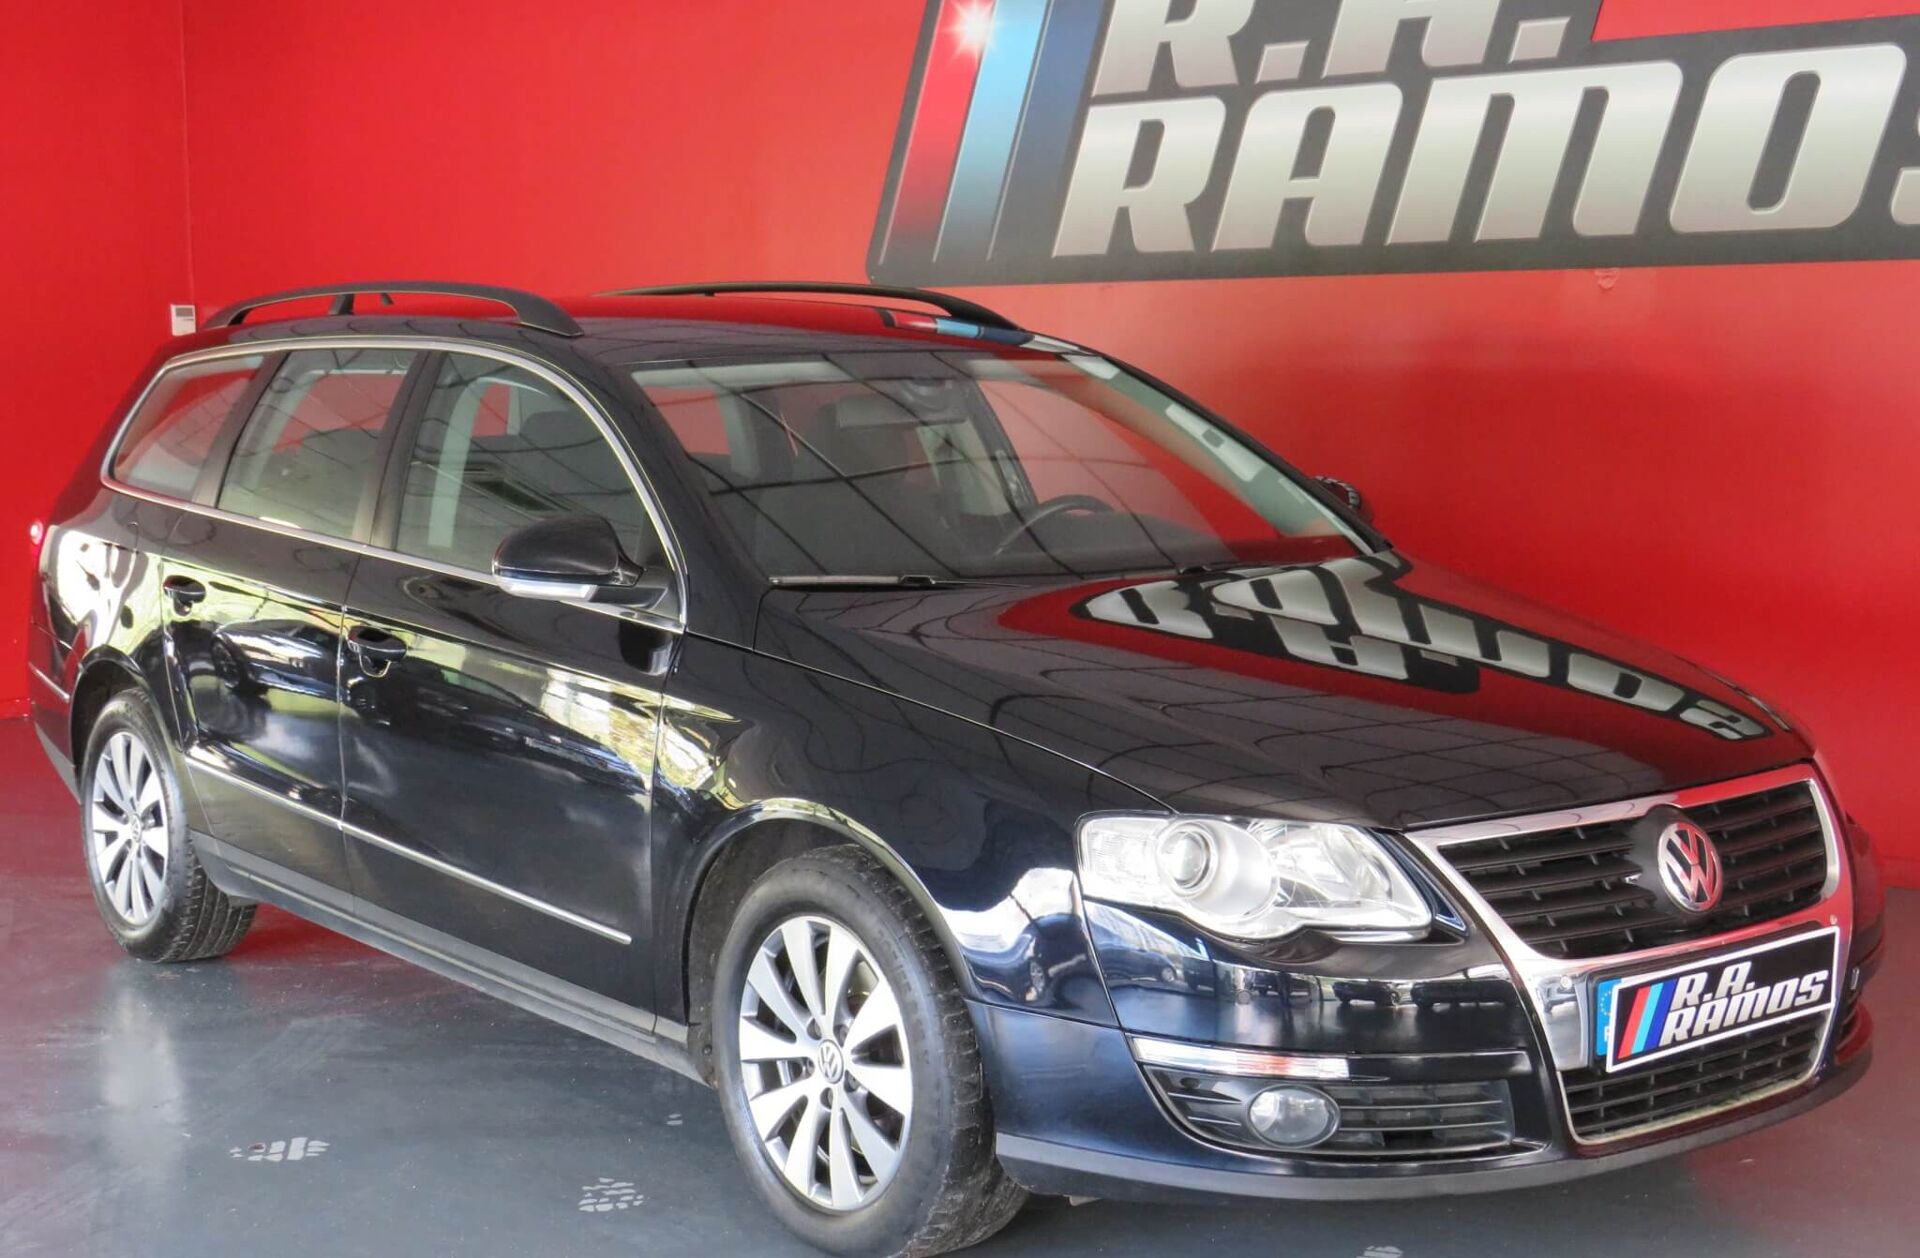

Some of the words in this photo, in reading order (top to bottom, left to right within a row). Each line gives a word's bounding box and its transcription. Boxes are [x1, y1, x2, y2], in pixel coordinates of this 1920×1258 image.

[1052, 43, 1920, 257] RAMO
[1658, 969, 1830, 1047] RAMOS
[1669, 961, 1756, 1011] R.A.
